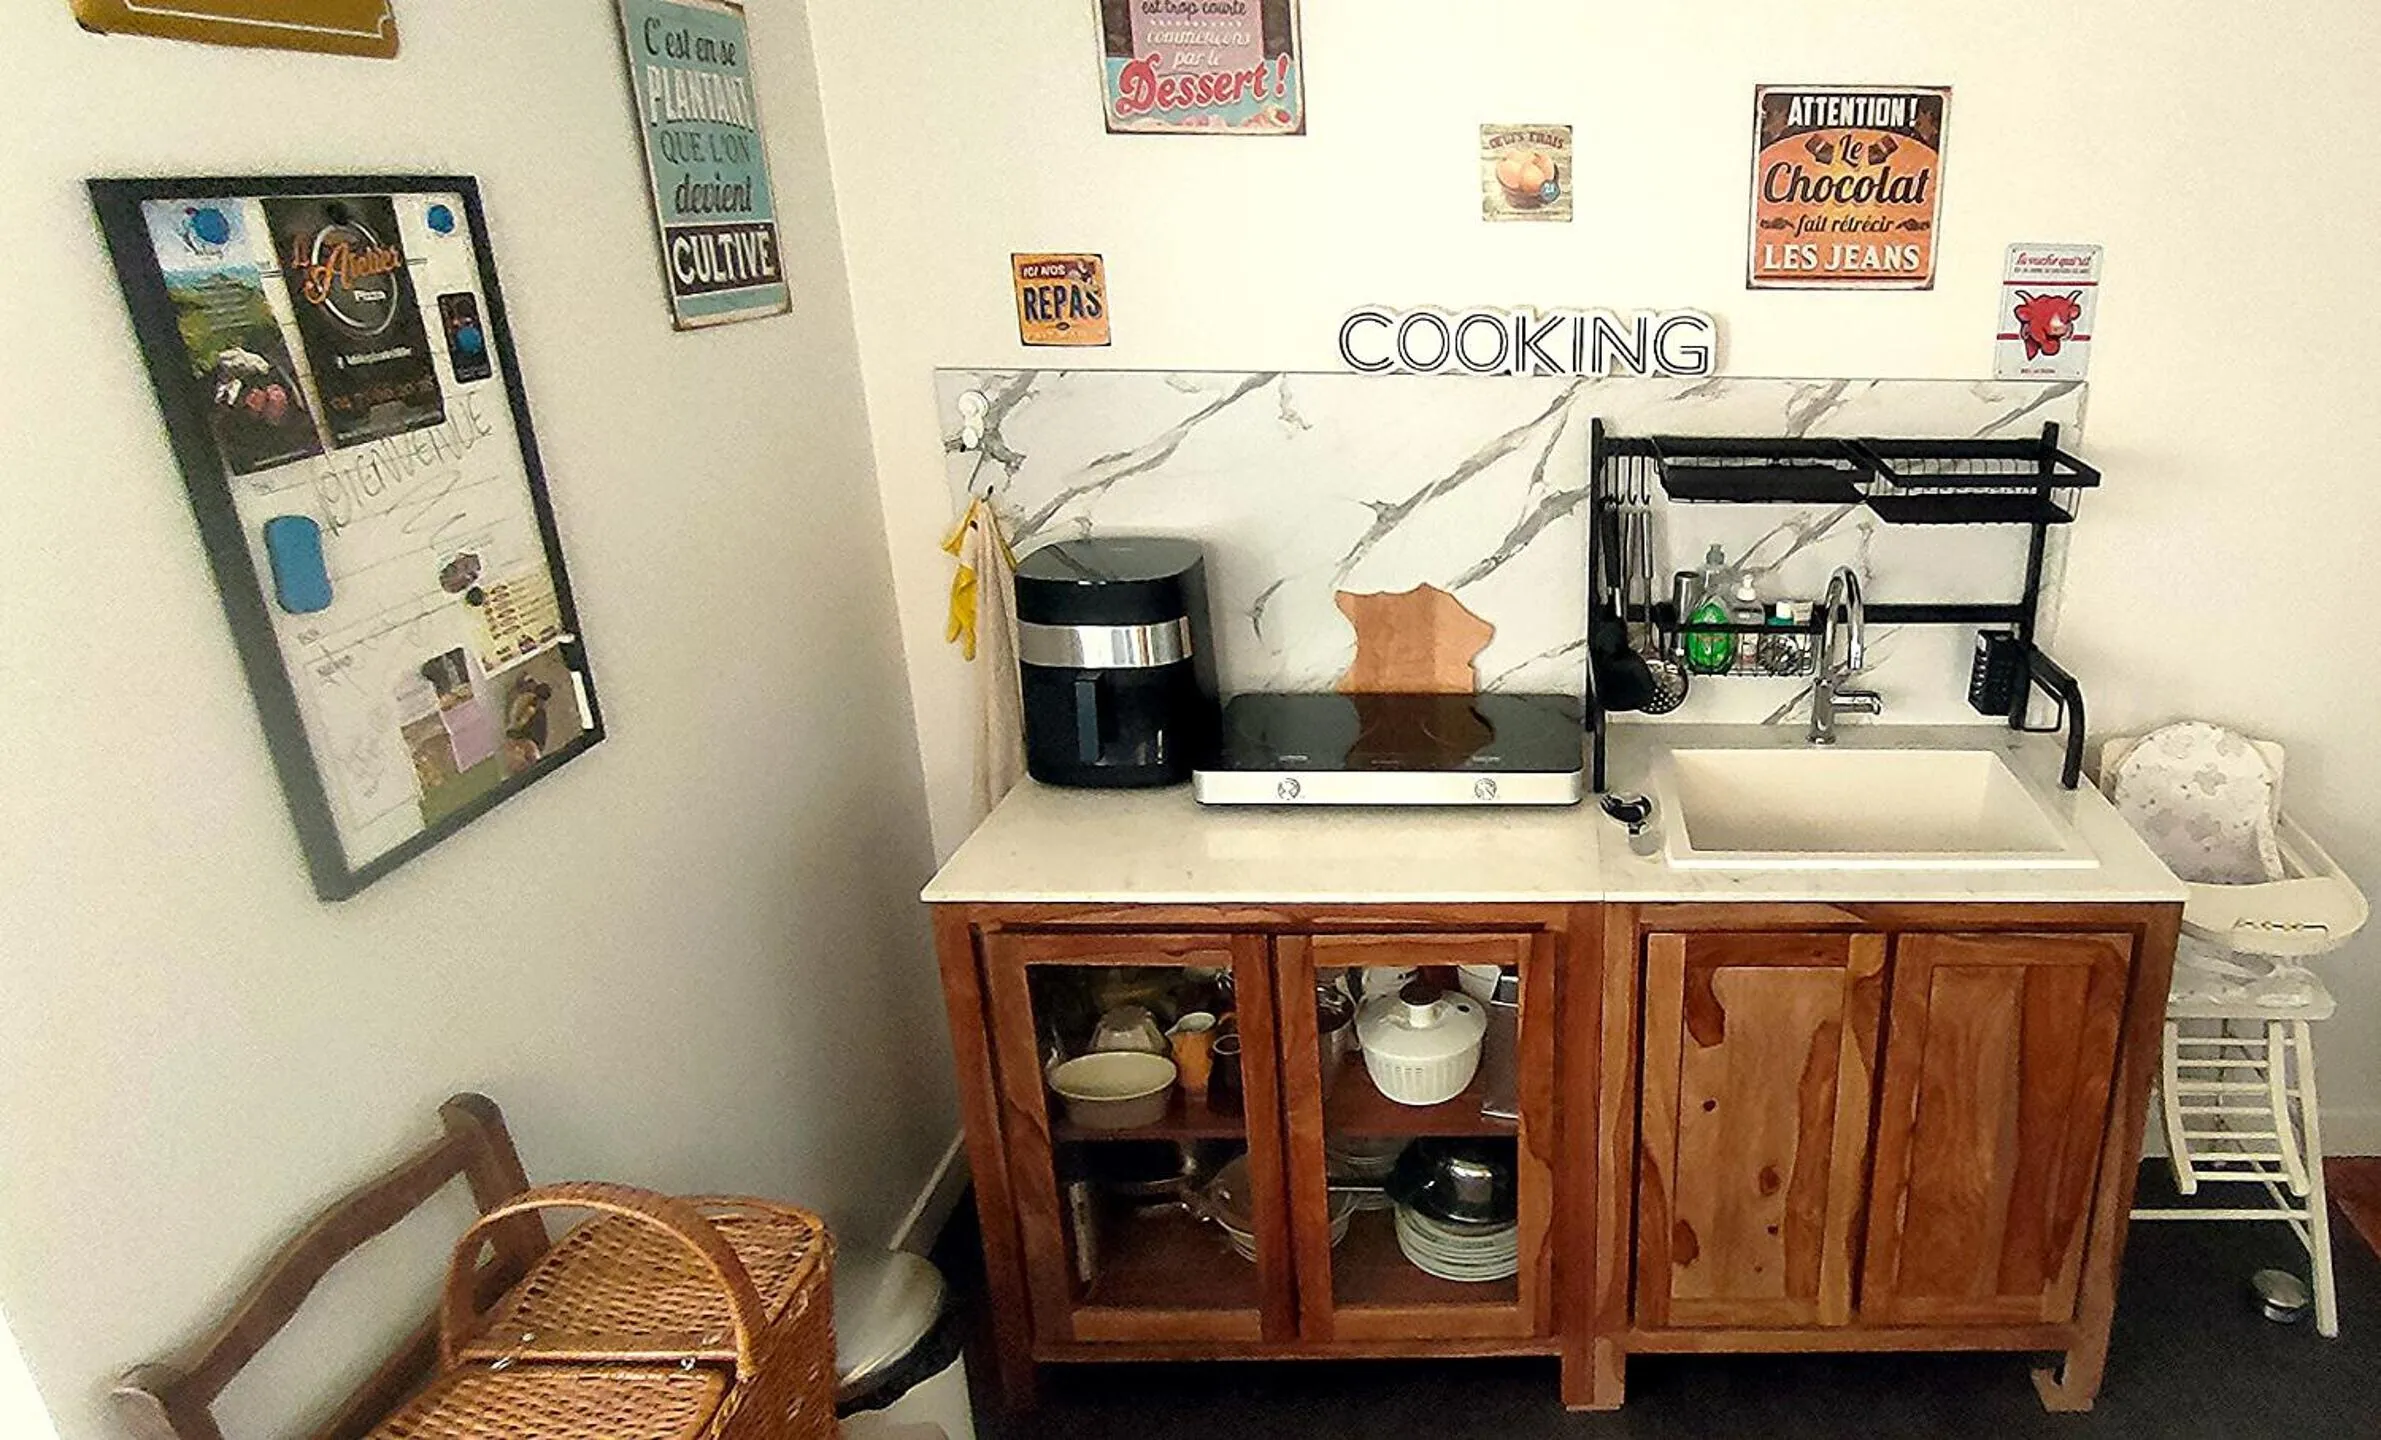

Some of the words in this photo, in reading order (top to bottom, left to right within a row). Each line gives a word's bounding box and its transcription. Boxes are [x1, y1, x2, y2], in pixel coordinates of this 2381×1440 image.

[1203, 0, 1247, 16] courte
[695, 35, 717, 63] en
[717, 39, 736, 66] se
[646, 64, 754, 132] PLANTANT
[660, 130, 703, 164] QUE
[709, 132, 751, 163] L'ON
[1839, 134, 1864, 168] Le
[675, 172, 752, 214] devient
[1763, 162, 1930, 205] Chocolat
[1793, 213, 1828, 238] fait
[1832, 214, 1895, 233] rétrécir
[1764, 244, 1818, 271] LES
[1824, 244, 1920, 271] JEANS
[1023, 284, 1102, 322] REPAS
[1338, 311, 1709, 376] COOKING
